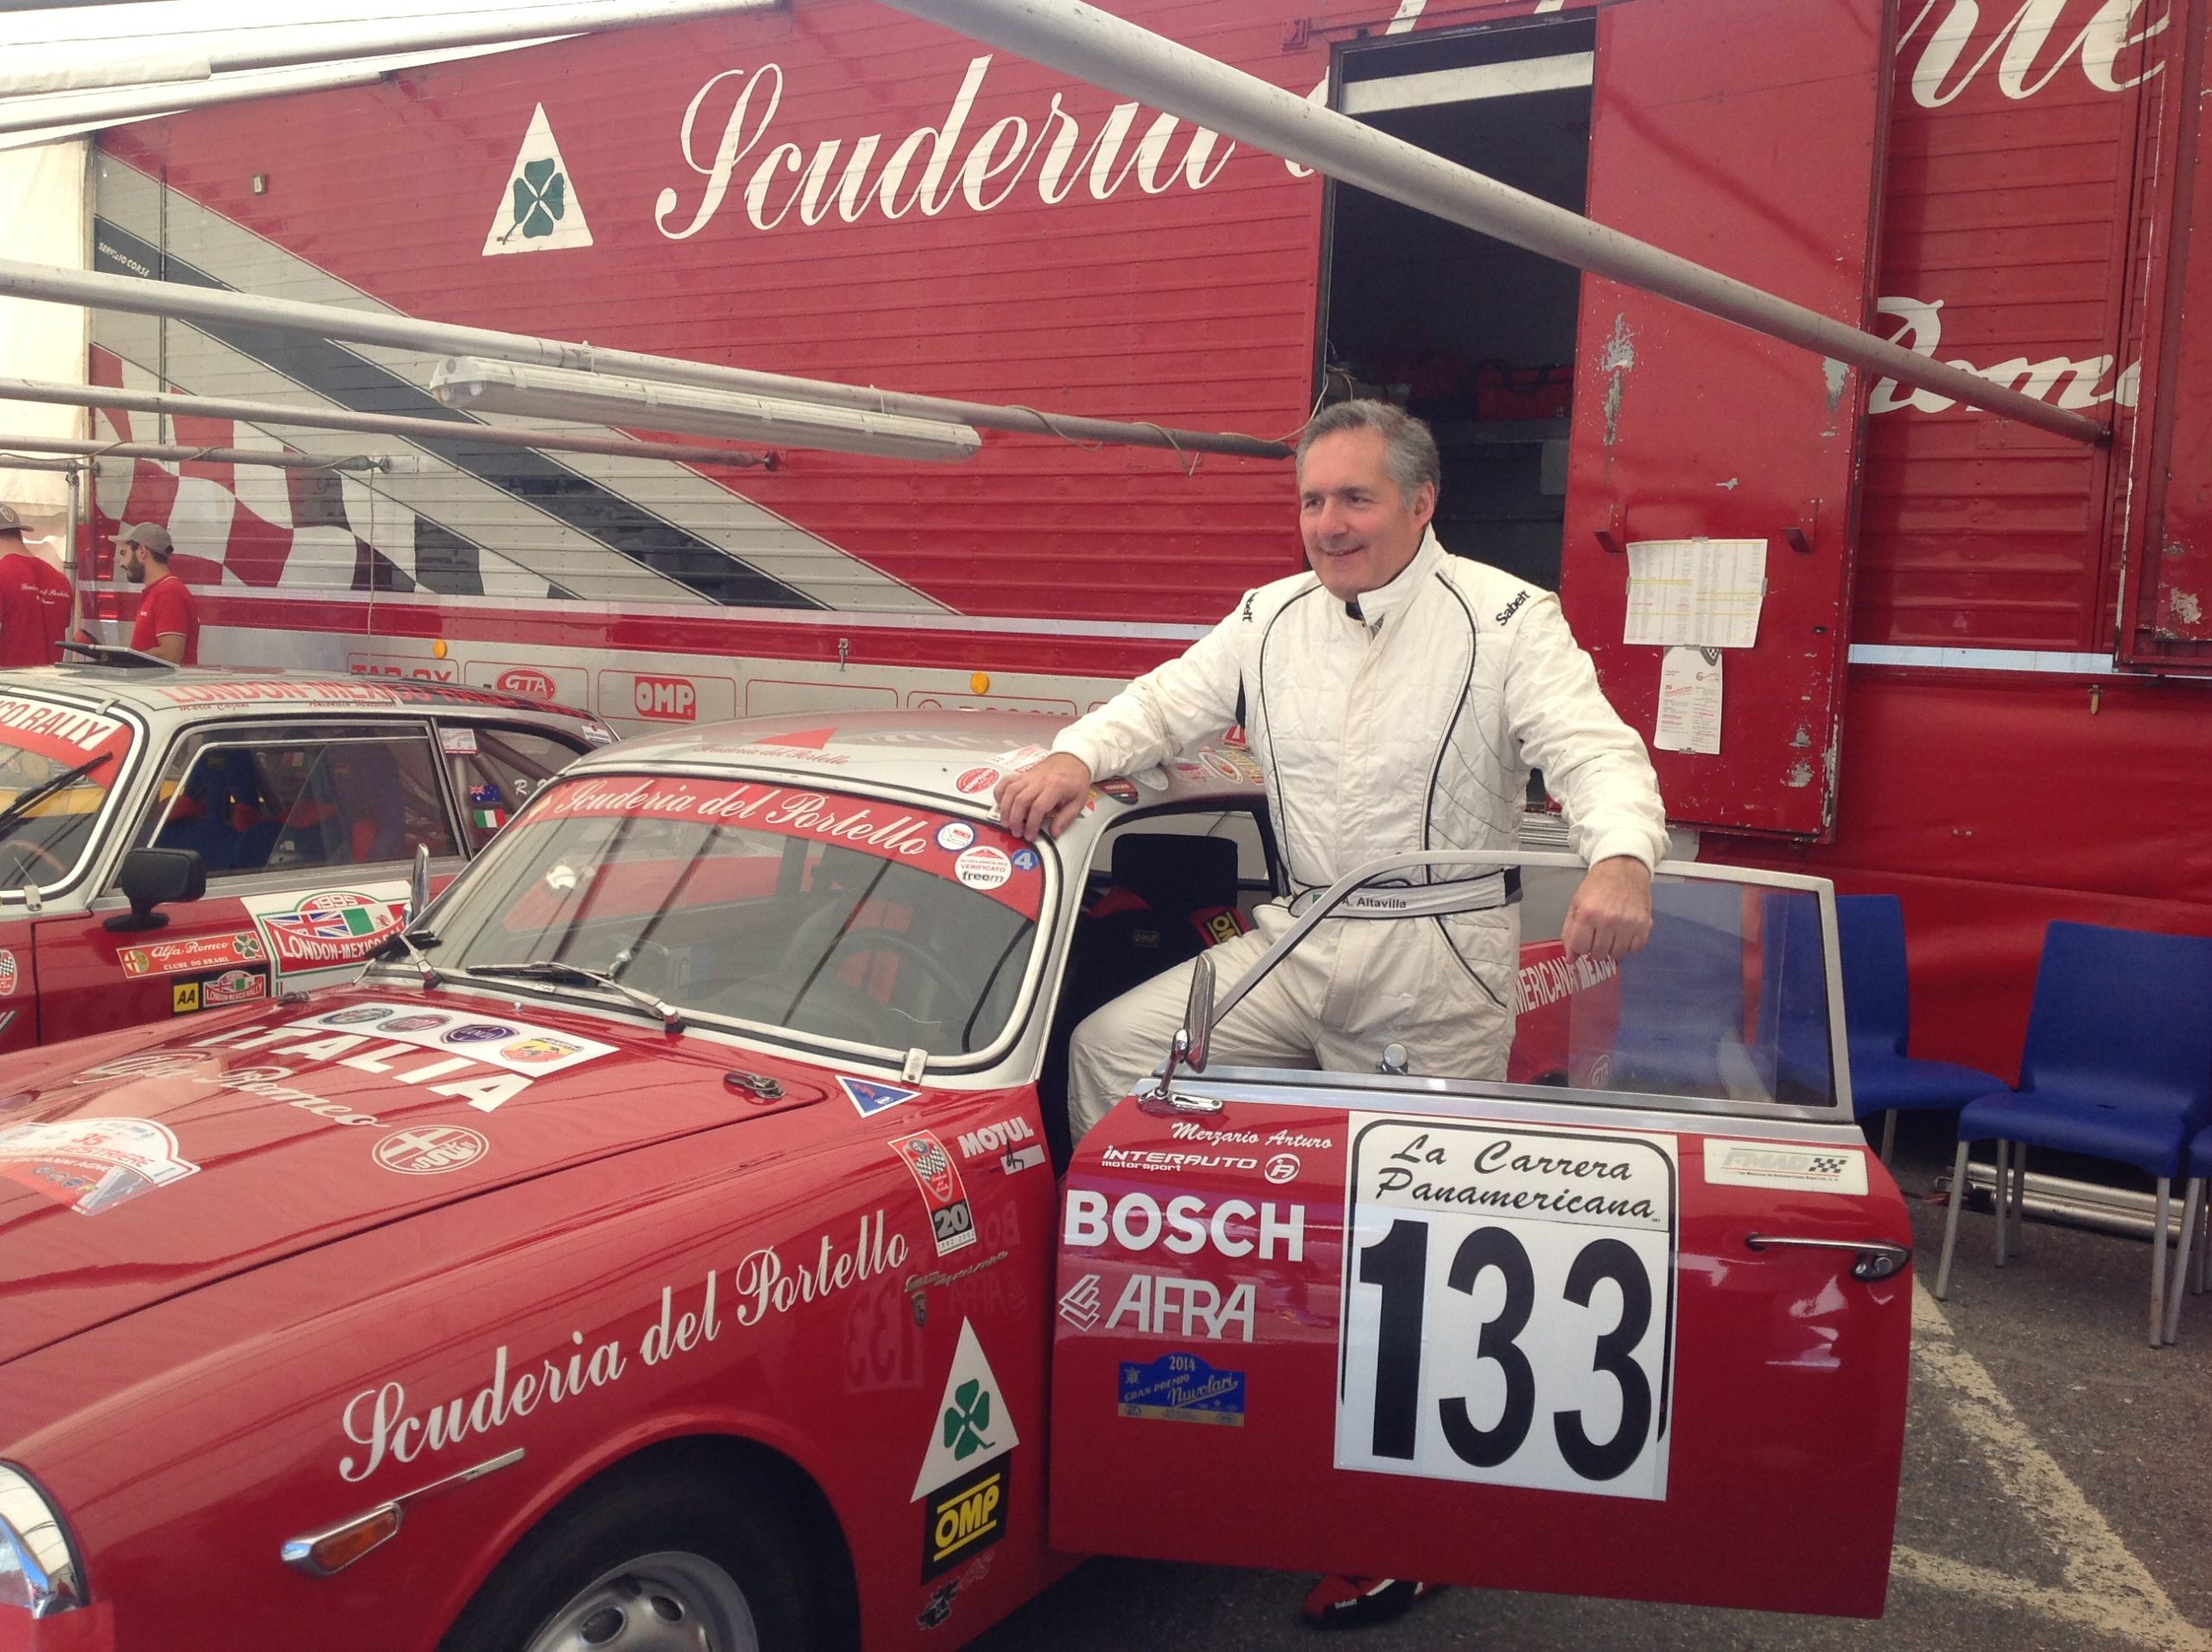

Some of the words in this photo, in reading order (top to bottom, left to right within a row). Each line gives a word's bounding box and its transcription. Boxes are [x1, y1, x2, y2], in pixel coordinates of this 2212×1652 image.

[654, 54, 1242, 240] Scuderia
[1495, 589, 1532, 626] Sabelt
[505, 674, 548, 694] GTA
[635, 681, 695, 715] OMP
[16, 707, 111, 746] RALLY
[553, 779, 695, 816] Scuderia
[689, 785, 781, 822] del
[766, 791, 929, 855] Portello
[962, 871, 1004, 883] freem
[1013, 851, 1033, 870] 4
[313, 894, 359, 908] 1995
[1356, 897, 1408, 909] Altavilla
[151, 944, 182, 961] Alfa
[185, 941, 228, 955] Romeo
[177, 988, 196, 1006] AA
[189, 1026, 534, 1113] ITALIA
[957, 1116, 1034, 1159] MOTUL
[1171, 1121, 1259, 1147] Merzario
[1265, 1128, 1332, 1149] Arturo
[1102, 1160, 1181, 1172] motorsport
[1390, 1134, 1446, 1165] La
[1474, 1140, 1633, 1181] Carrera
[1375, 1167, 1656, 1219] Panamericana
[934, 1204, 969, 1239] 20
[1064, 1189, 1305, 1262] BOSCH
[1104, 1274, 1256, 1343] AFRA
[339, 1331, 628, 1483] Scuderia
[639, 1269, 721, 1367] del
[735, 1209, 910, 1327] Portello
[1168, 1355, 1197, 1372] 2014
[1357, 1217, 1653, 1482] 133
[935, 1484, 1000, 1548] OMP
